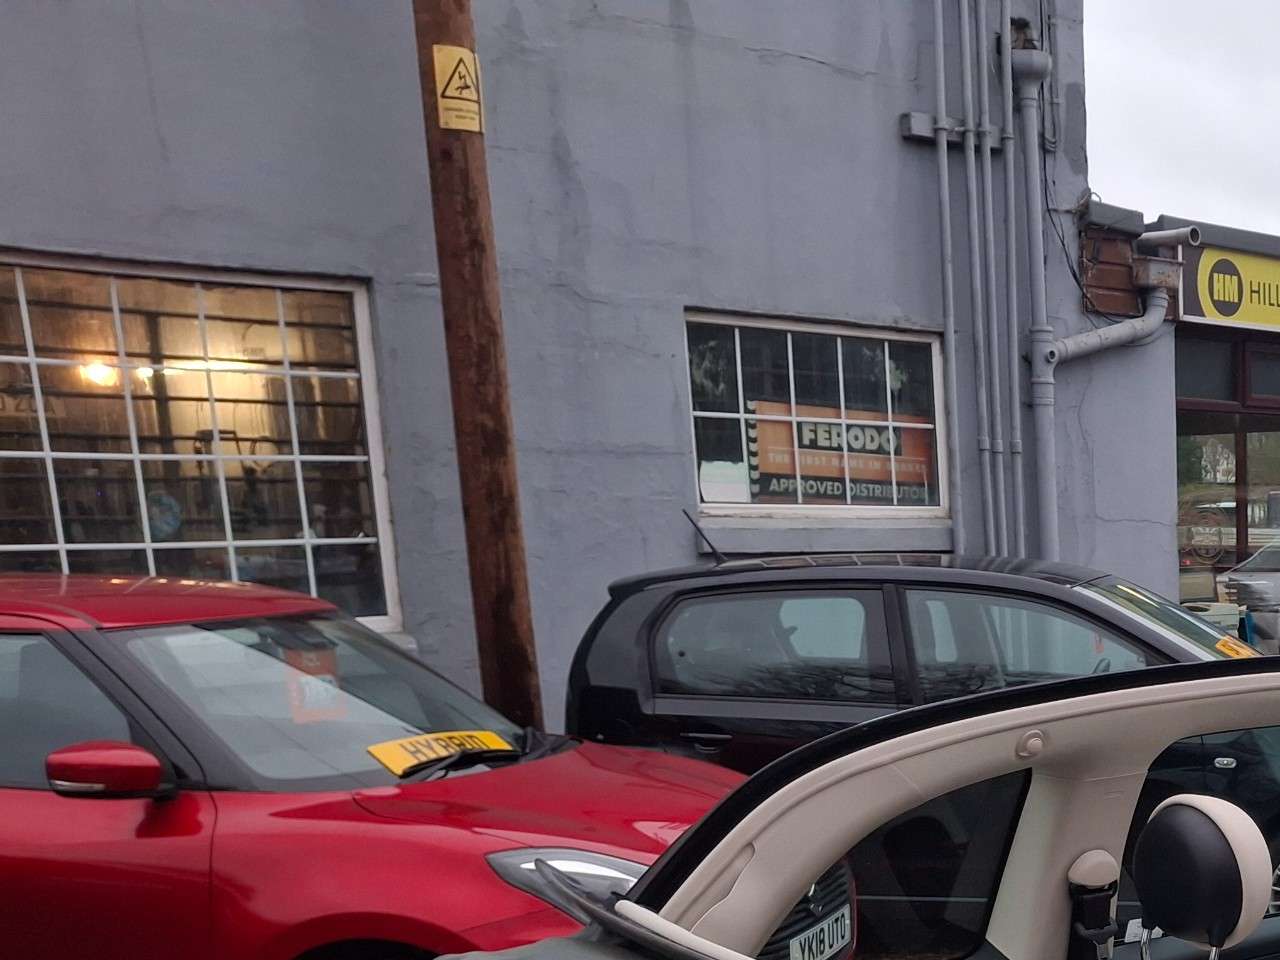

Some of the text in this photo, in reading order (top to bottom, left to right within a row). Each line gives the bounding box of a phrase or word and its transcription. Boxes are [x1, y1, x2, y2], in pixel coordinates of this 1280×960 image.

[801, 422, 898, 452] FERODO
[797, 455, 826, 466] IRST
[769, 478, 842, 496] APPROVED
